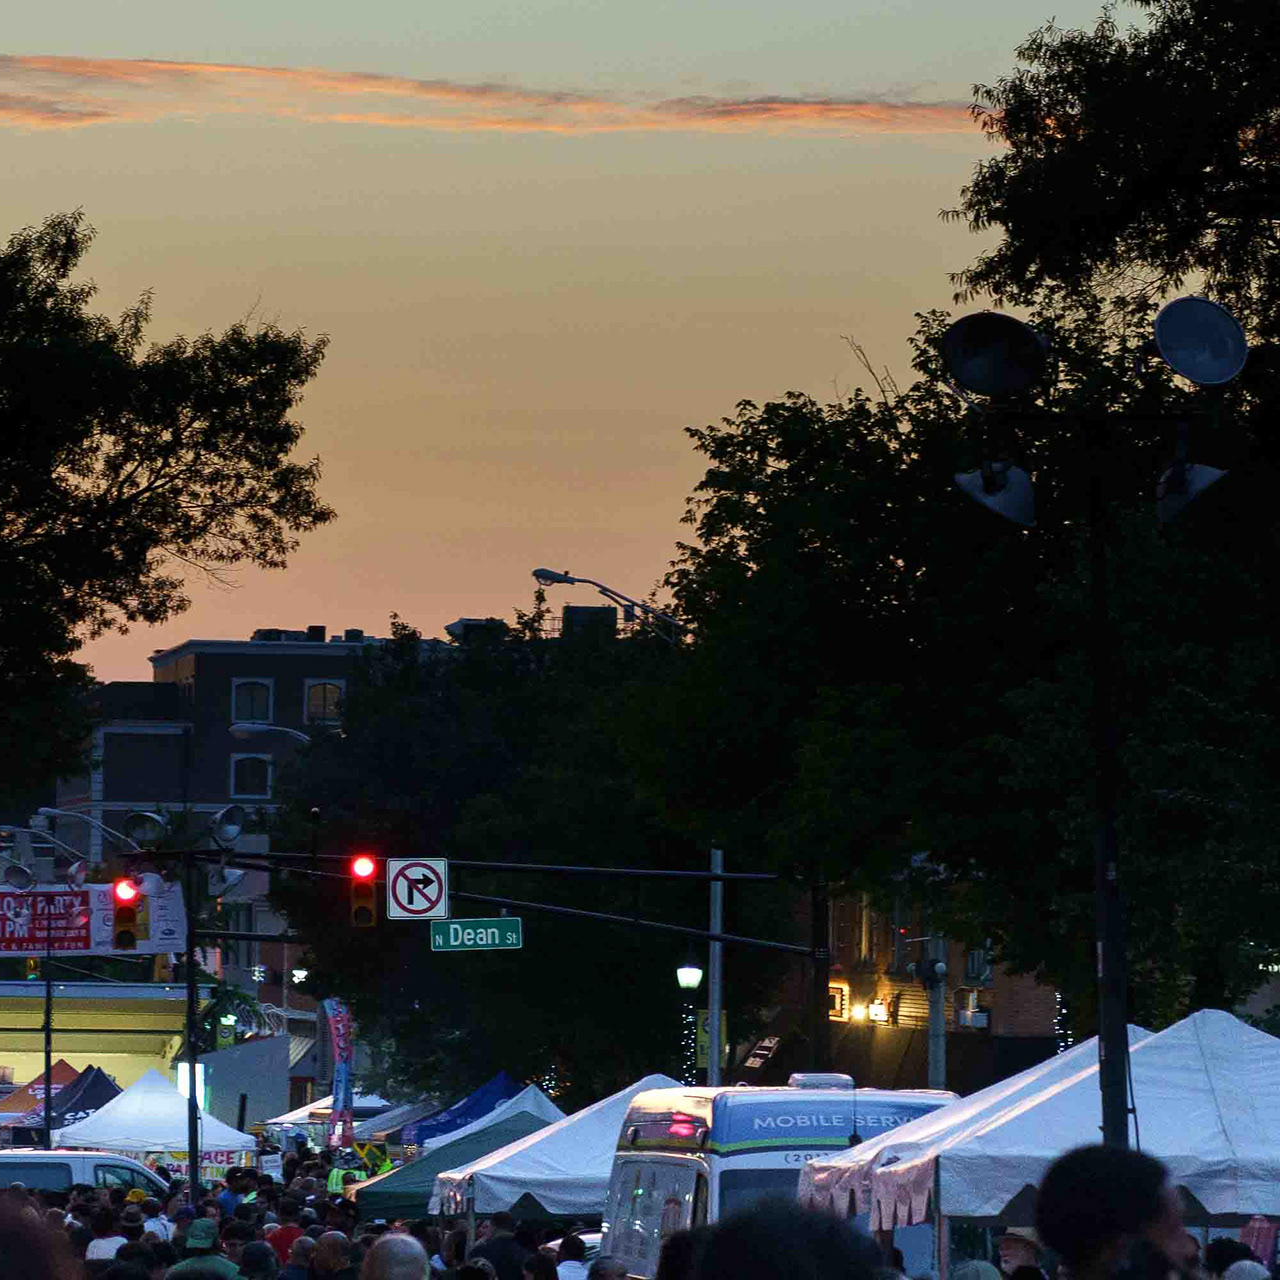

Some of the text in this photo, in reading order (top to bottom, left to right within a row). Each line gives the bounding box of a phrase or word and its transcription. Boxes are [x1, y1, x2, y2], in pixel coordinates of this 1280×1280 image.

[434, 923, 518, 947] N Dean St
[753, 1114, 911, 1131] MOBILE SERV
